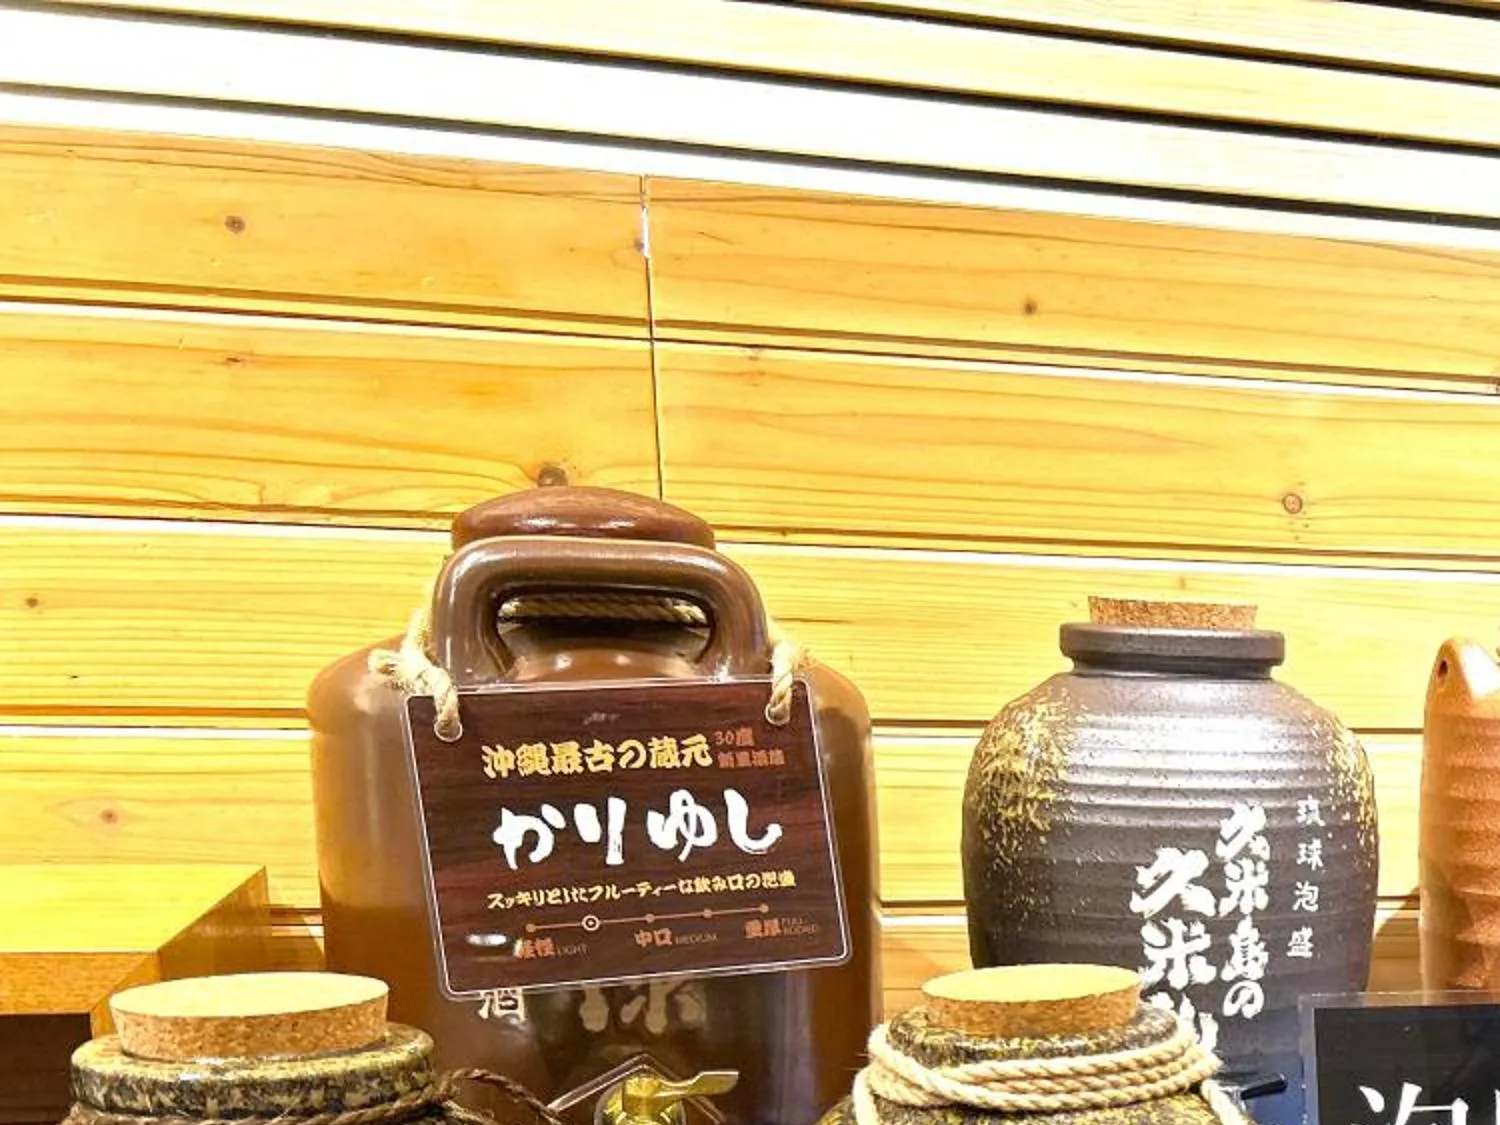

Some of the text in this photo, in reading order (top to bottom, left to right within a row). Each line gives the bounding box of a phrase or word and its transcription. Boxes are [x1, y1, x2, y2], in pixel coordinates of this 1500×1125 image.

[481, 733, 713, 779] 沖縄最古の蔵元
[493, 789, 783, 870] かりゆし
